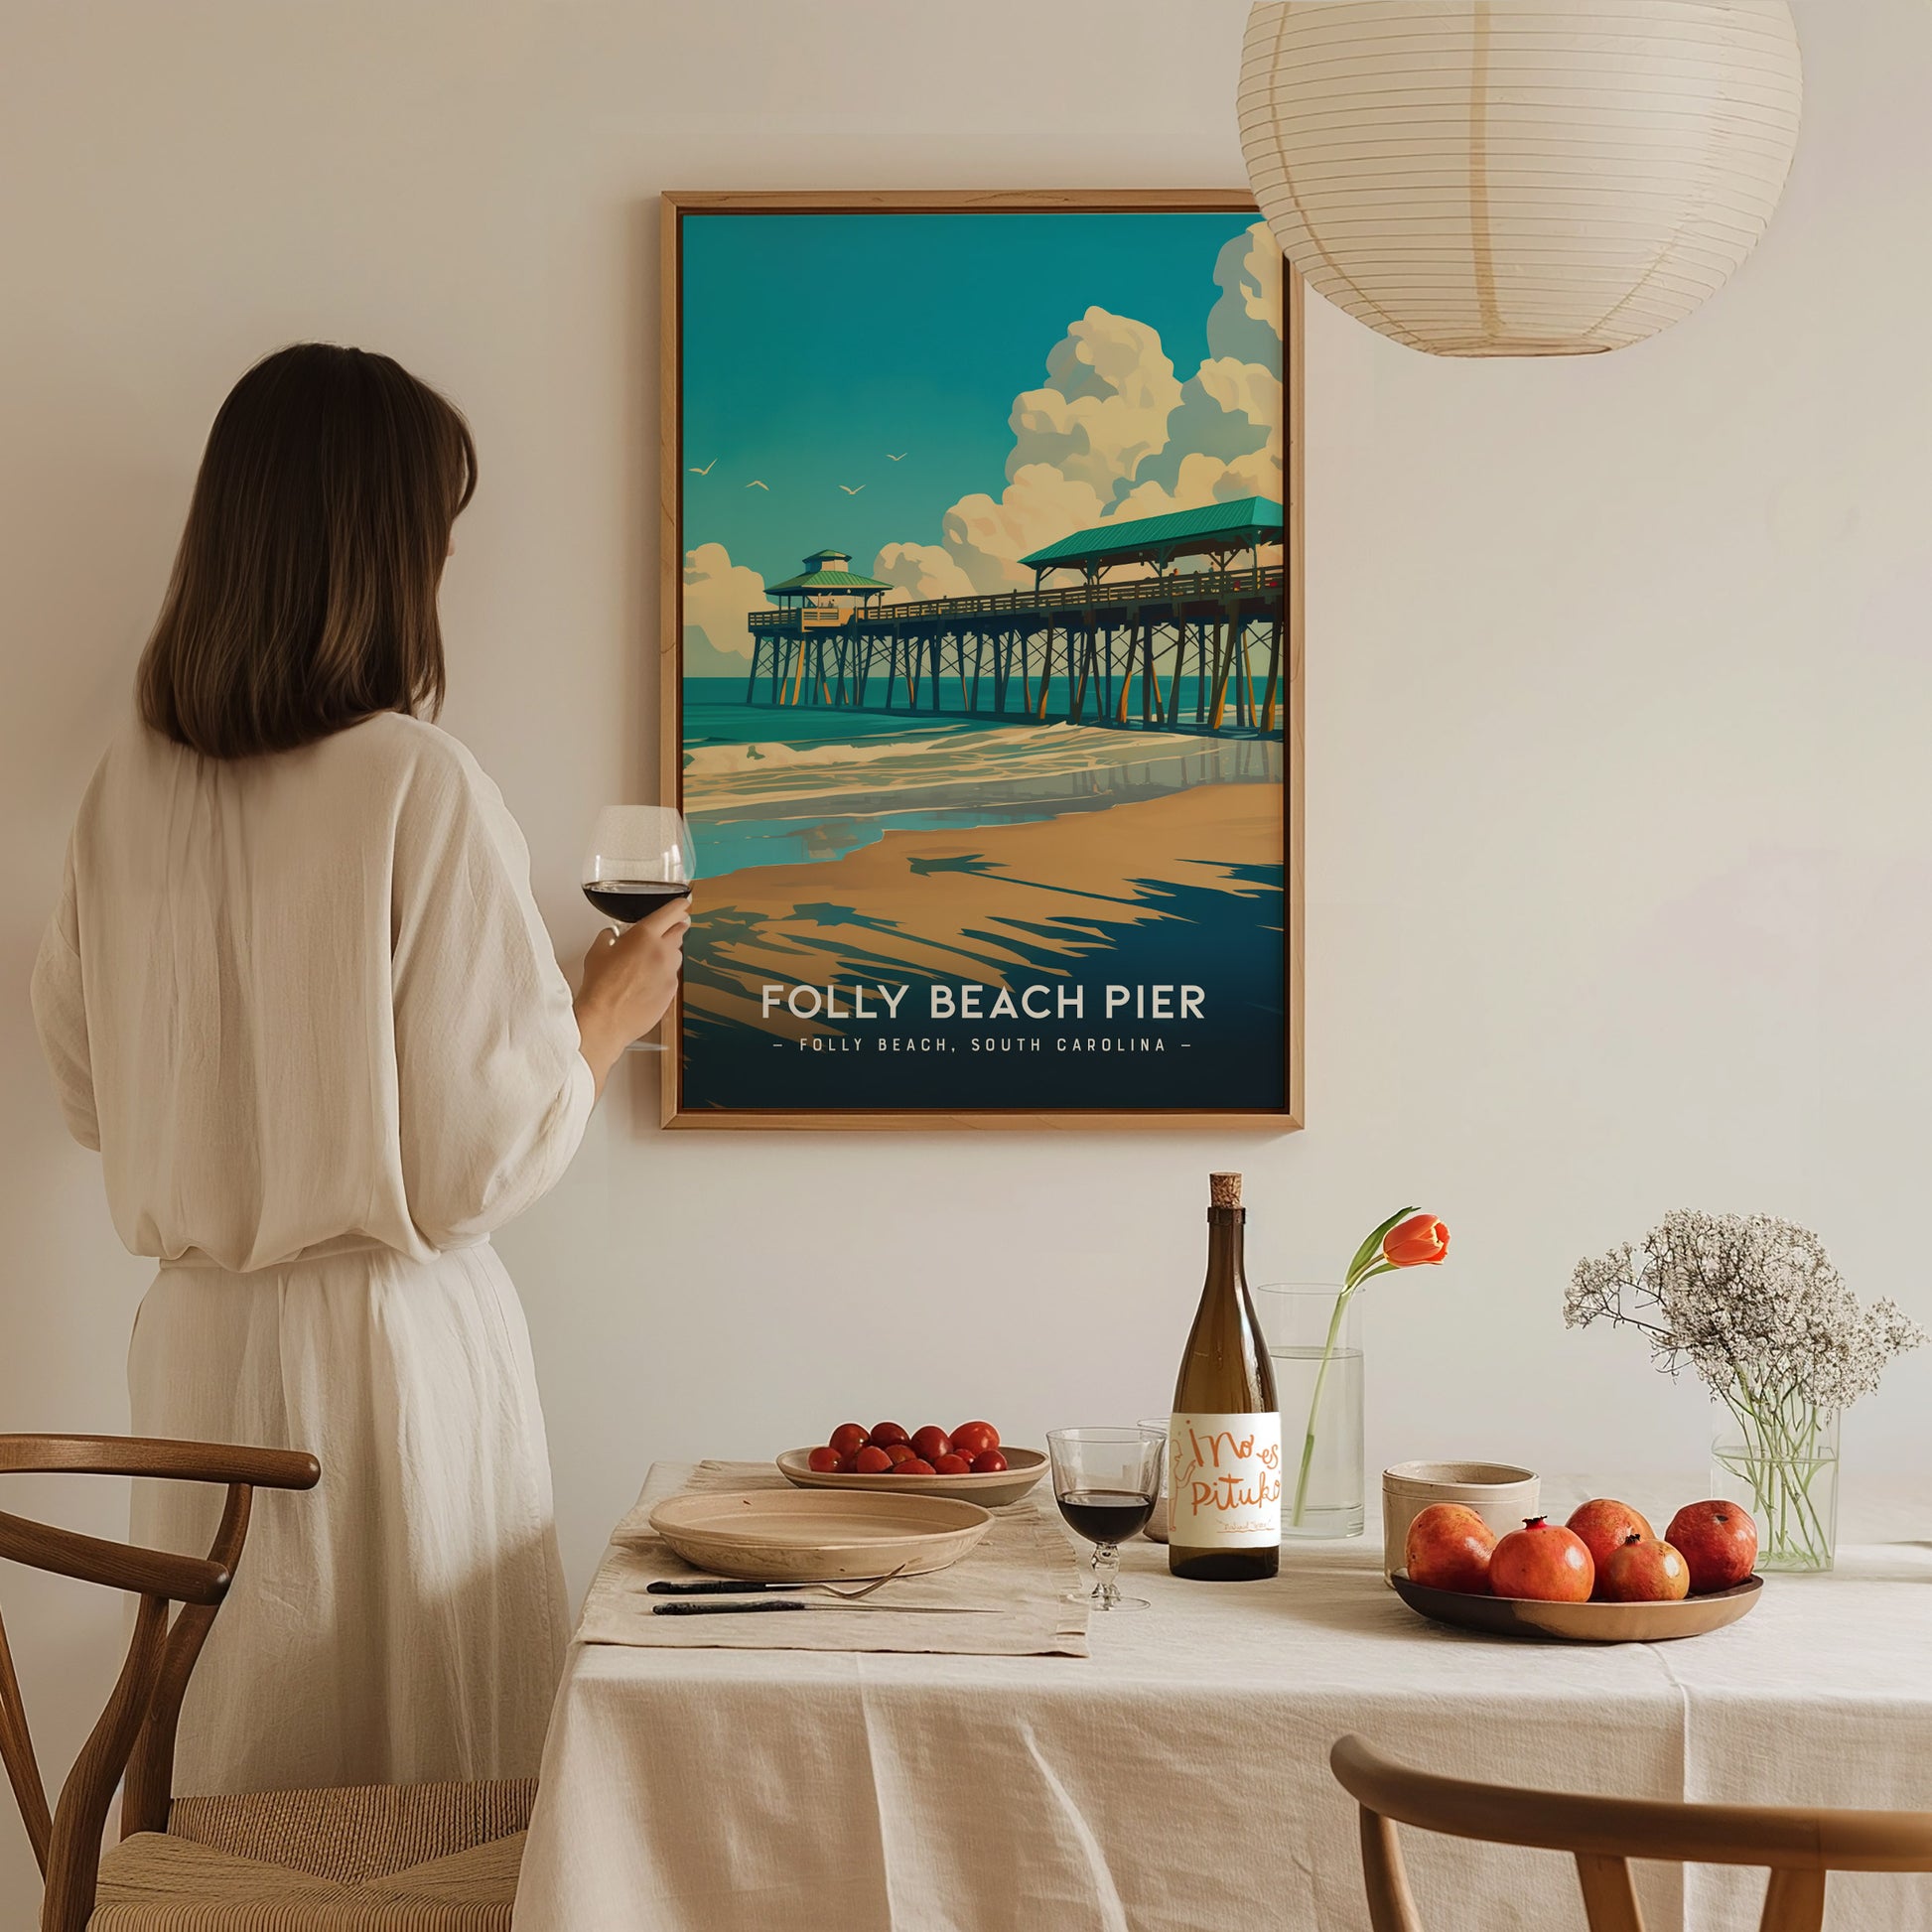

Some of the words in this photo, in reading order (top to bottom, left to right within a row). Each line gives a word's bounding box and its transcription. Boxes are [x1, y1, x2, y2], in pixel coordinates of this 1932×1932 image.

[761, 984, 909, 1020] FOLLY
[930, 984, 1084, 1020] BEACH
[1105, 984, 1205, 1020] PIER
[799, 1037, 862, 1051] FOLLY
[879, 1037, 956, 1053] BEACH,
[971, 1037, 1040, 1051] SOUTH
[1056, 1037, 1166, 1051] CAROLINA
